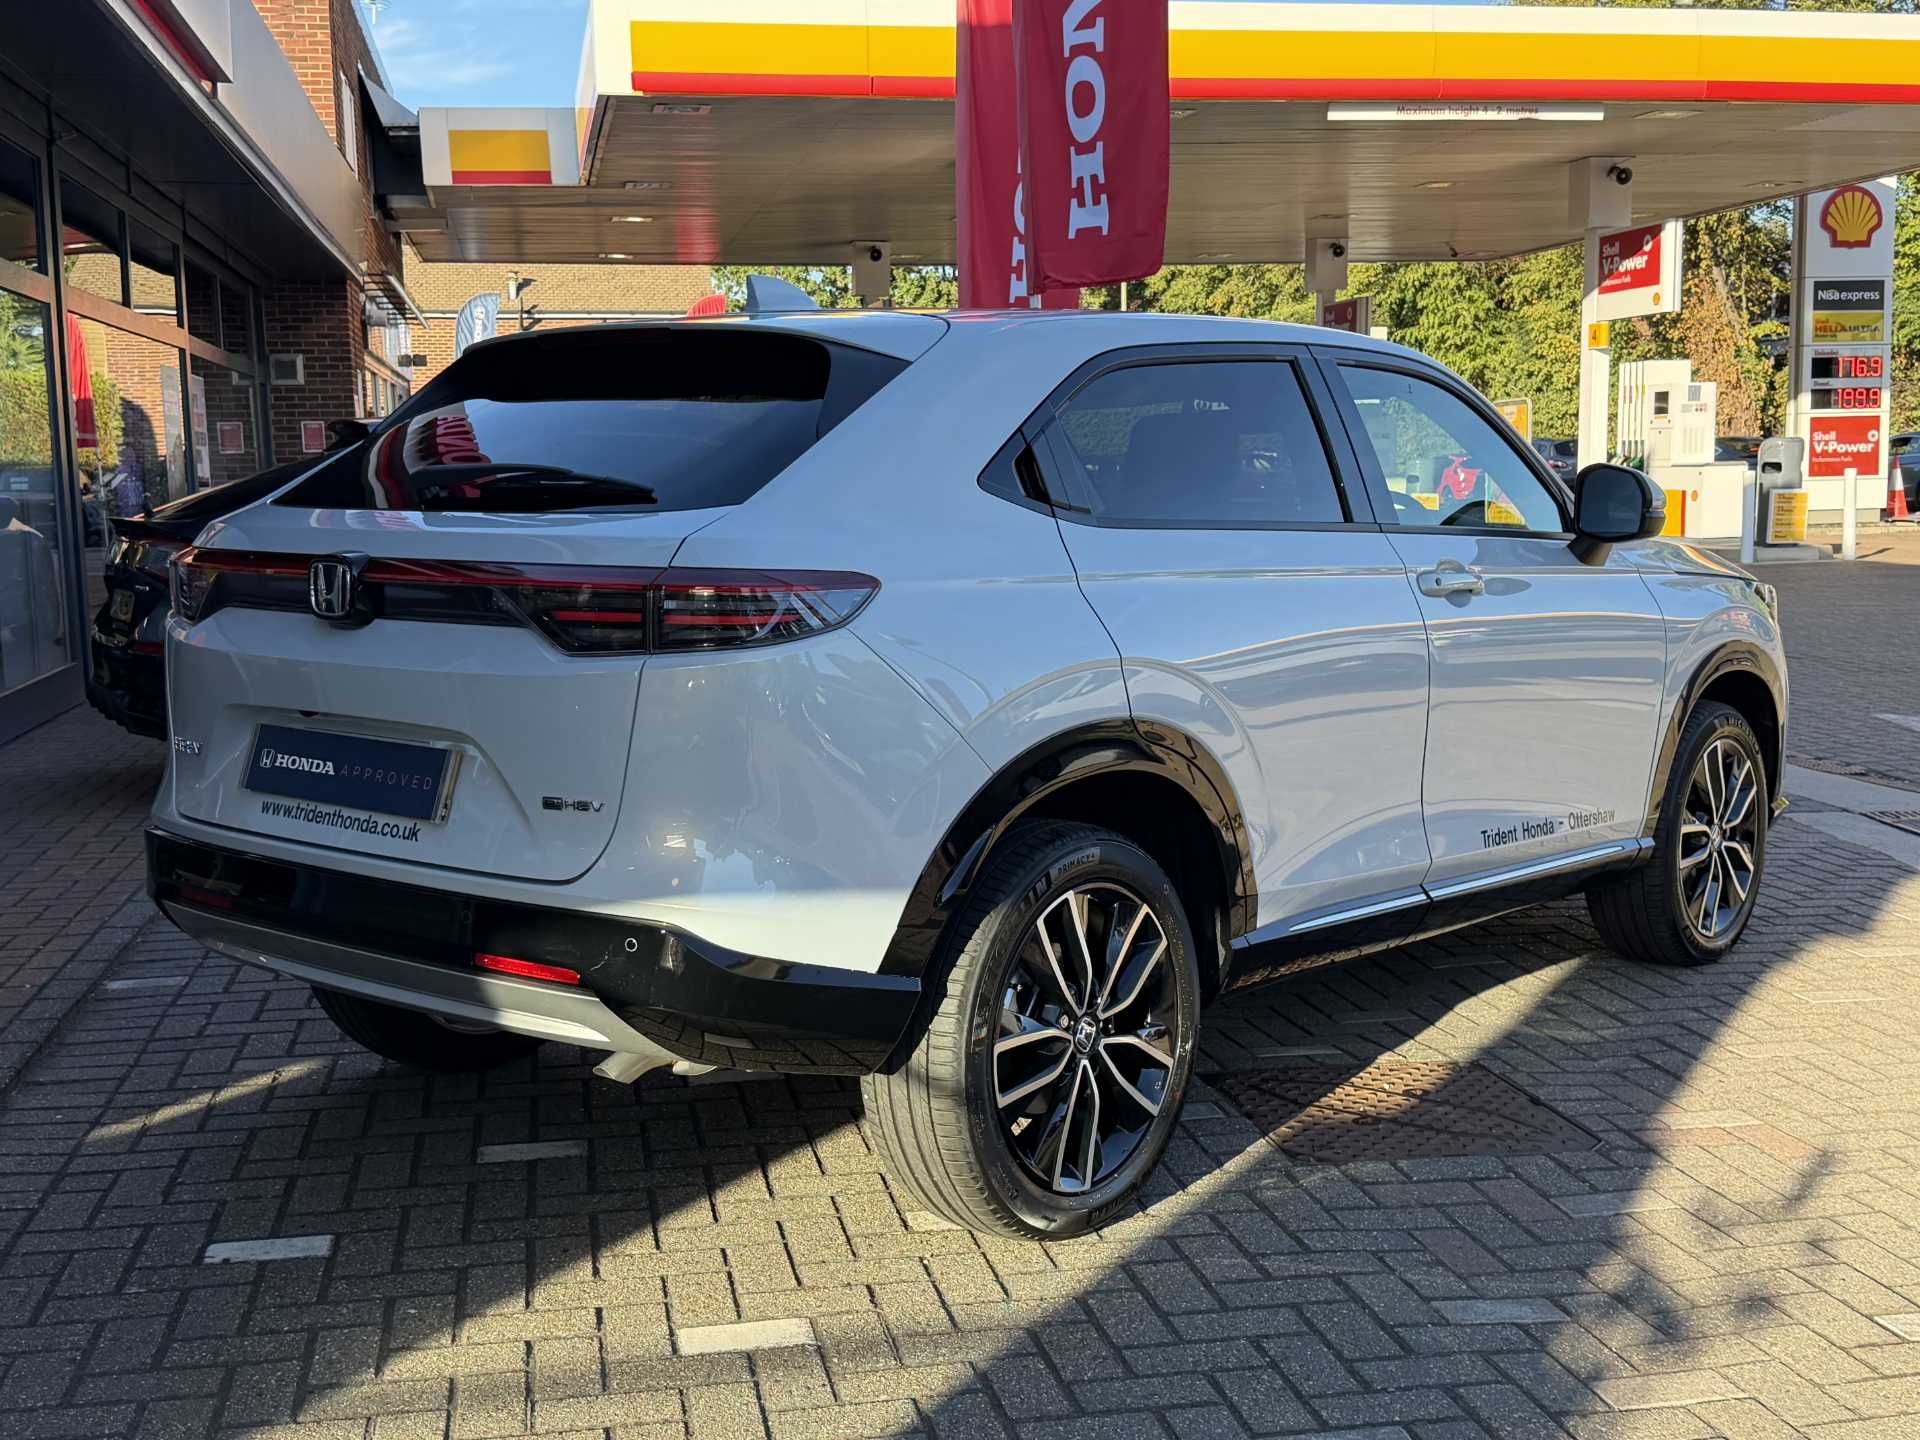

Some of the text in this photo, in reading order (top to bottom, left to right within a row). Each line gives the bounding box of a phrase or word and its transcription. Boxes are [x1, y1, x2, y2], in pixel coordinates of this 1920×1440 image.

[1396, 105, 1445, 116] Maximum
[1448, 104, 1479, 117] height
[1506, 105, 1538, 115] metres
[1603, 241, 1620, 257] Shell
[1603, 256, 1648, 276] V-Power
[1817, 289, 1880, 302] Nisa express
[1591, 328, 1597, 344] 4
[1838, 357, 1881, 377] 176.9
[1837, 388, 1880, 408] 199.9
[1812, 430, 1837, 441] Shell
[1812, 441, 1874, 454] V-Power
[275, 753, 433, 791] HONDA APPROVED
[261, 800, 422, 843] www.tridenthonda.co.uk
[1480, 827, 1519, 849] Trident
[1521, 816, 1555, 841] Honda
[1567, 807, 1616, 830] Ottershaw
